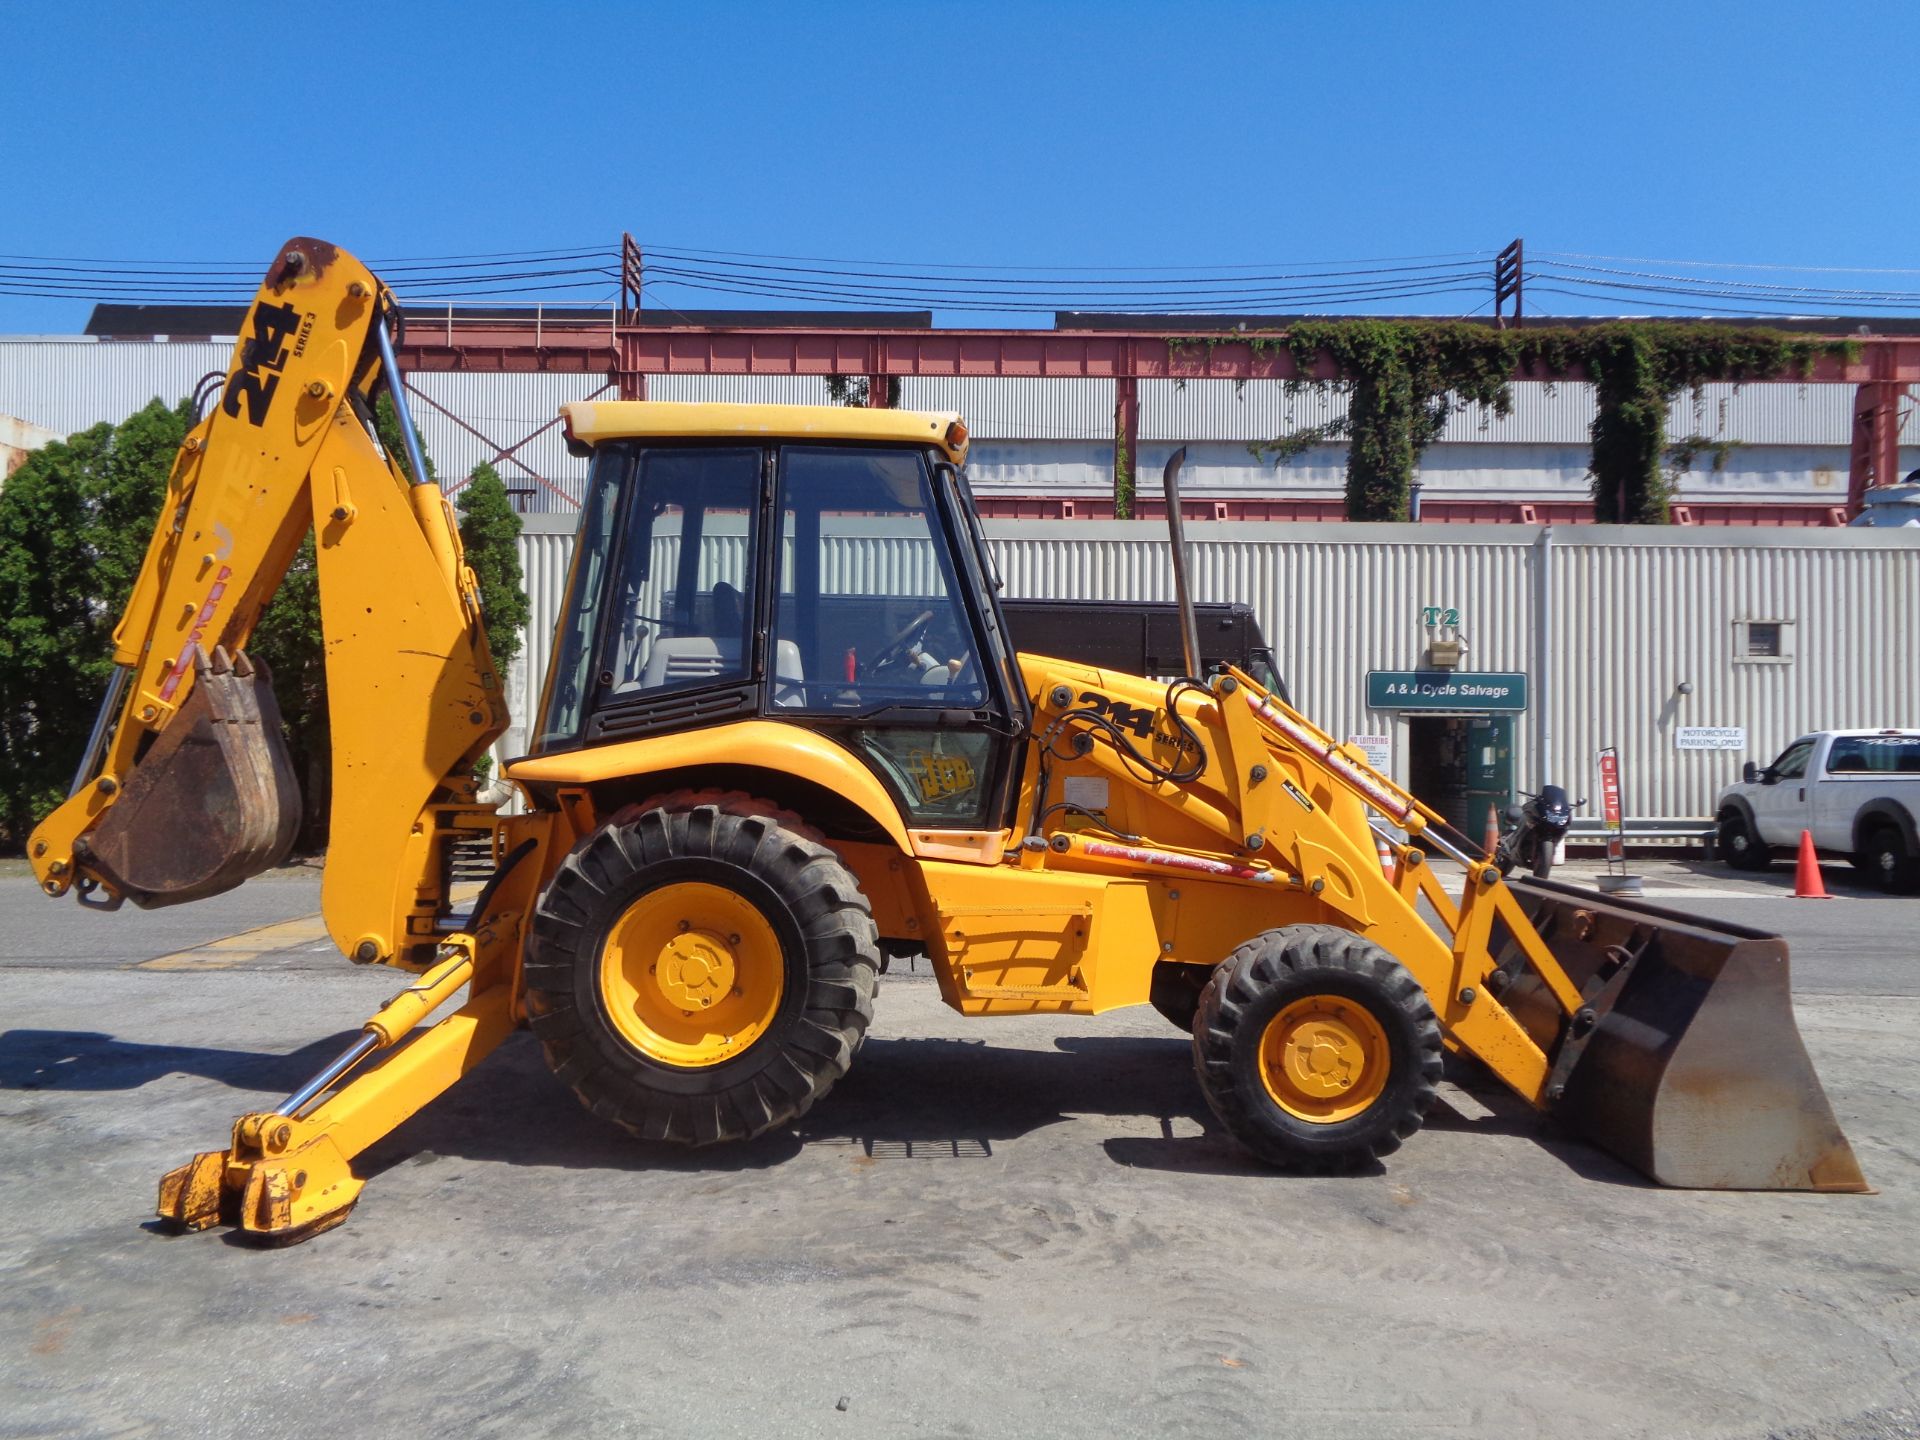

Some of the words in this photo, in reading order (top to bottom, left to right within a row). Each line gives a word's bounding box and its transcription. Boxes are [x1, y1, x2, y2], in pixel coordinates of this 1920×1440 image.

[293, 321, 313, 358] SERIES
[306, 311, 316, 320] 3
[222, 301, 302, 427] 214
[1385, 683, 1396, 695] A
[1398, 683, 1409, 695] &
[1410, 683, 1419, 695] J
[1421, 683, 1457, 698] Cycle
[1460, 684, 1509, 699] Salvage
[1359, 736, 1389, 745] LOITERING
[1682, 729, 1740, 738] MOTORCYCLE
[1680, 738, 1718, 747] PARKING
[1720, 739, 1744, 747] ONLY
[920, 755, 971, 797] JCB
